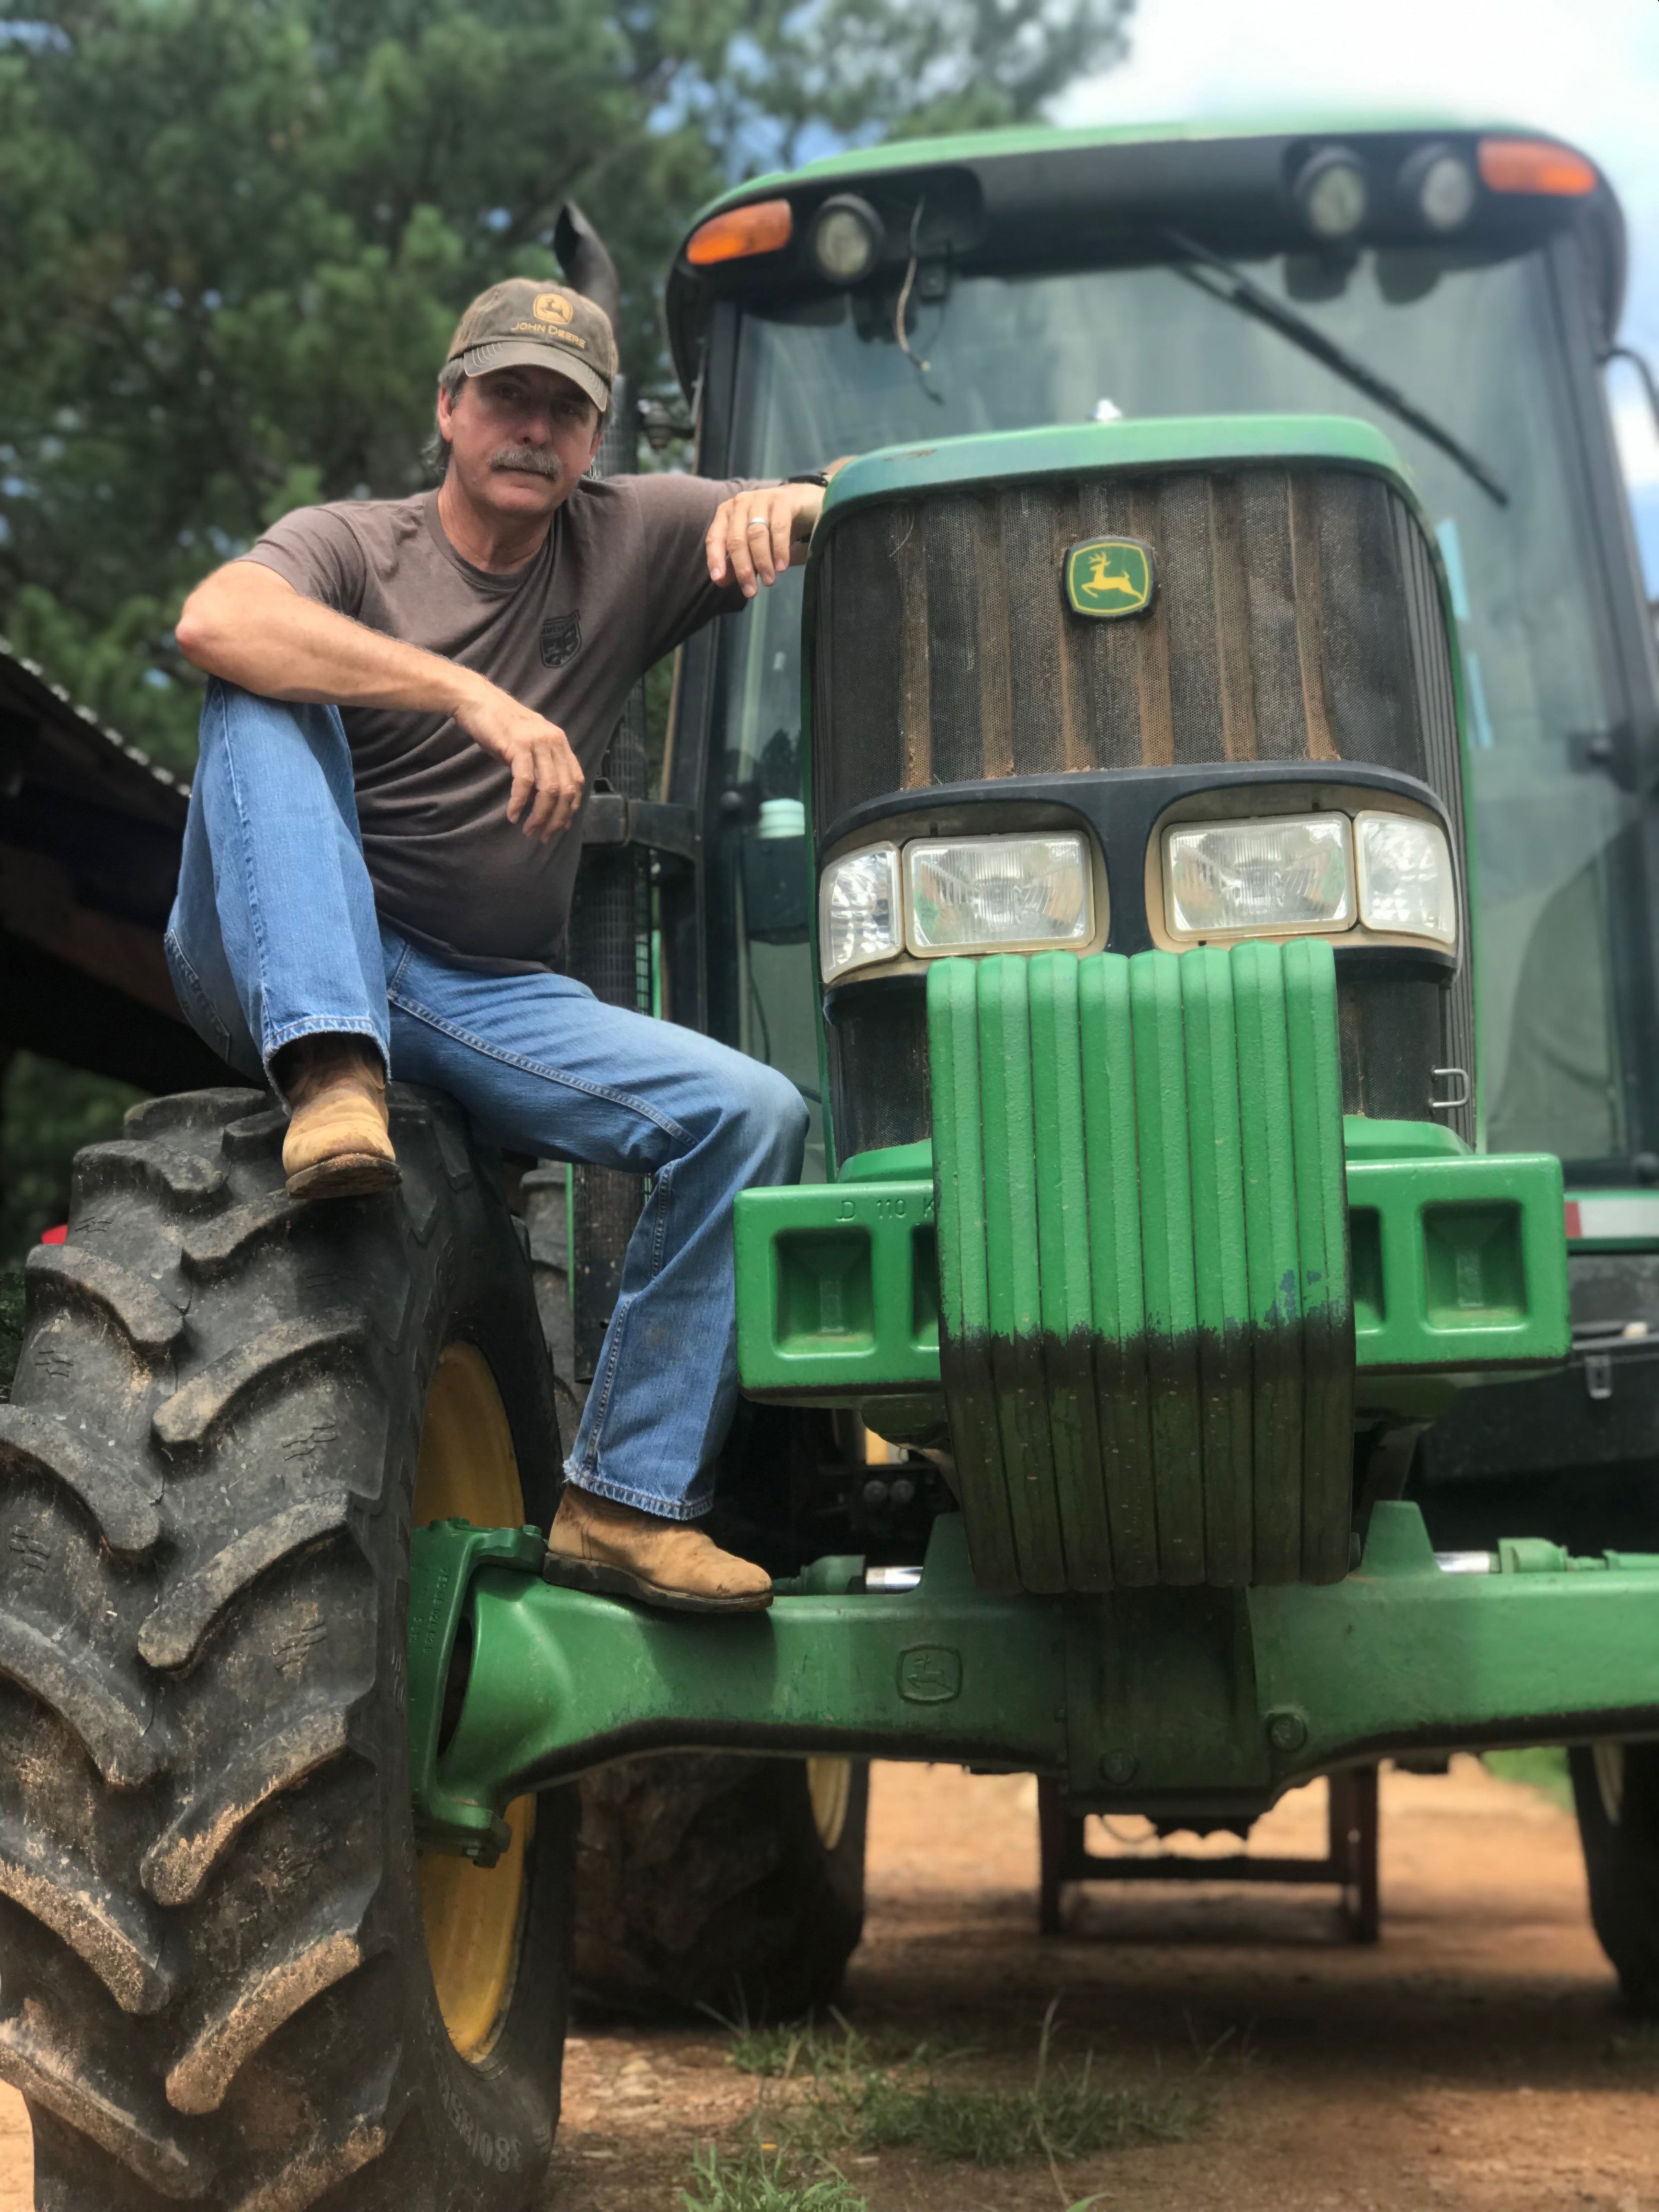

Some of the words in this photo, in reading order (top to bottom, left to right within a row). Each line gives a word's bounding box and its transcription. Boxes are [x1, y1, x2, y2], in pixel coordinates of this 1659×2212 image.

[511, 322, 545, 332] JOHN
[547, 325, 586, 349] DEERE
[876, 1199, 906, 1220] 110
